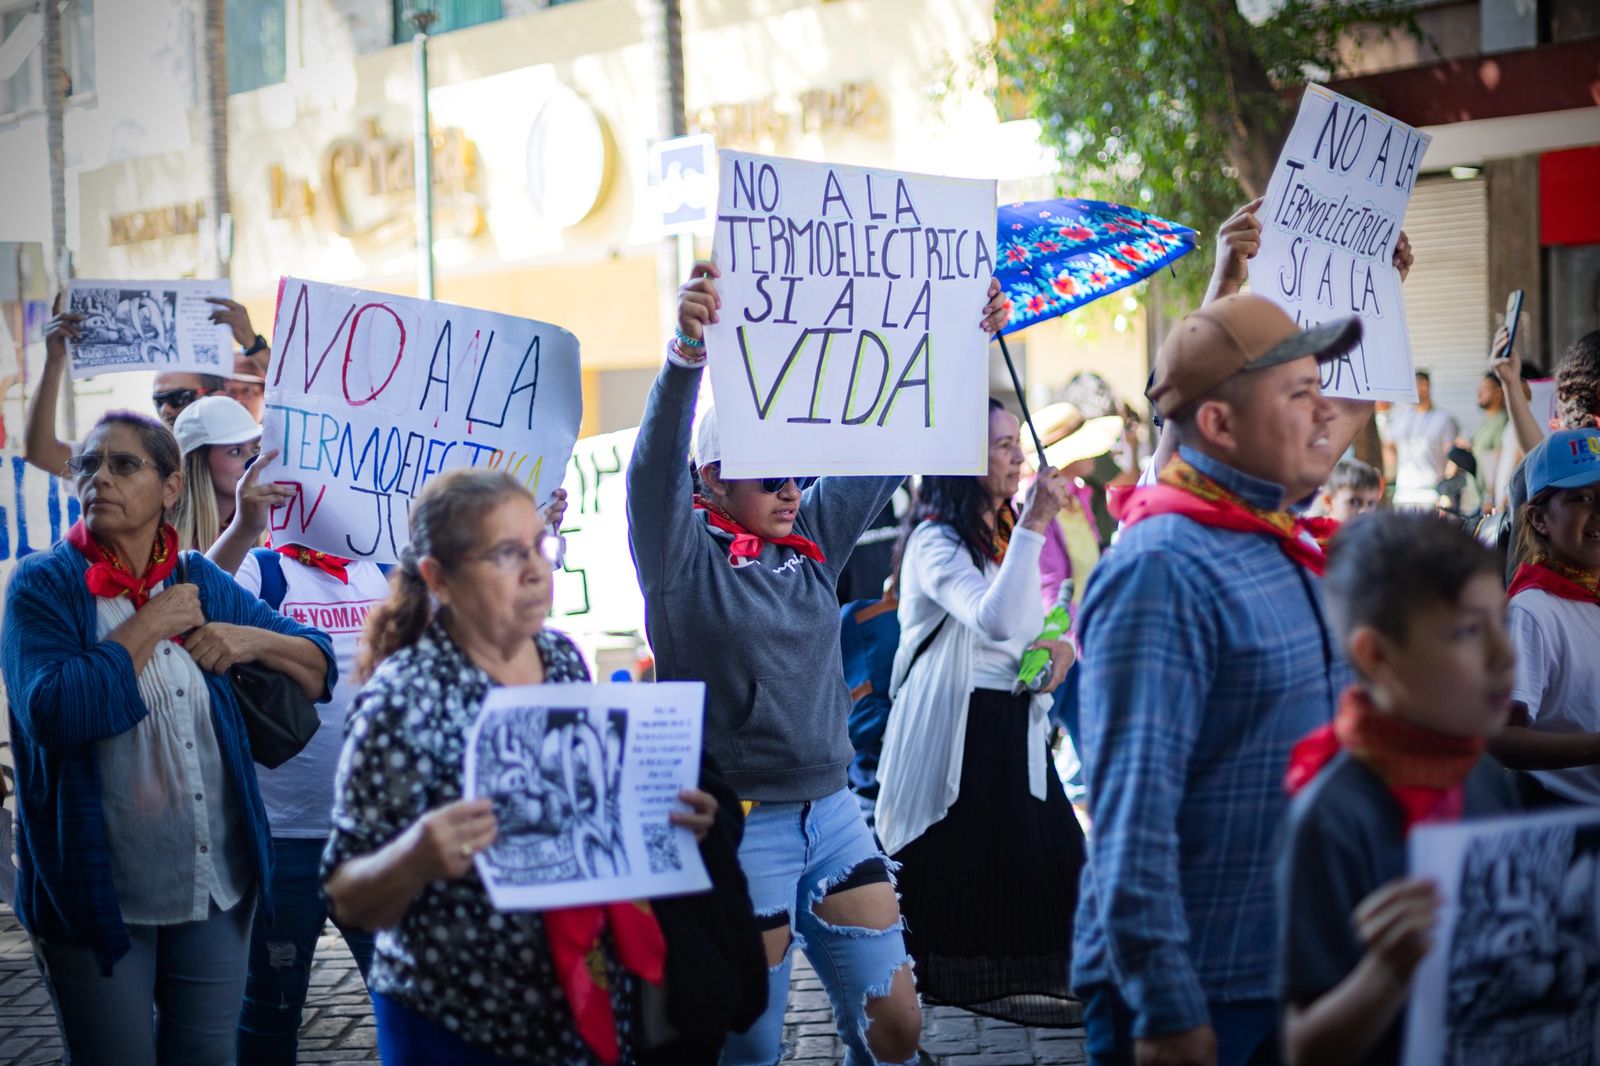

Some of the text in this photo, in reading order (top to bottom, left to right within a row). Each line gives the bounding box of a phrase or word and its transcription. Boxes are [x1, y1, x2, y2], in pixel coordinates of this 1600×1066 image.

[1313, 101, 1422, 194] NO A LA
[734, 160, 921, 225] NO A LA
[1274, 159, 1395, 263] TERMOELECTRICA
[718, 215, 993, 280] TERMOELECTRICA
[1280, 236, 1380, 315] SI A LA
[743, 275, 932, 330] SI A LA
[273, 283, 407, 406] NO
[419, 319, 453, 413] A
[465, 330, 541, 430] LA
[736, 325, 936, 428] VIDA
